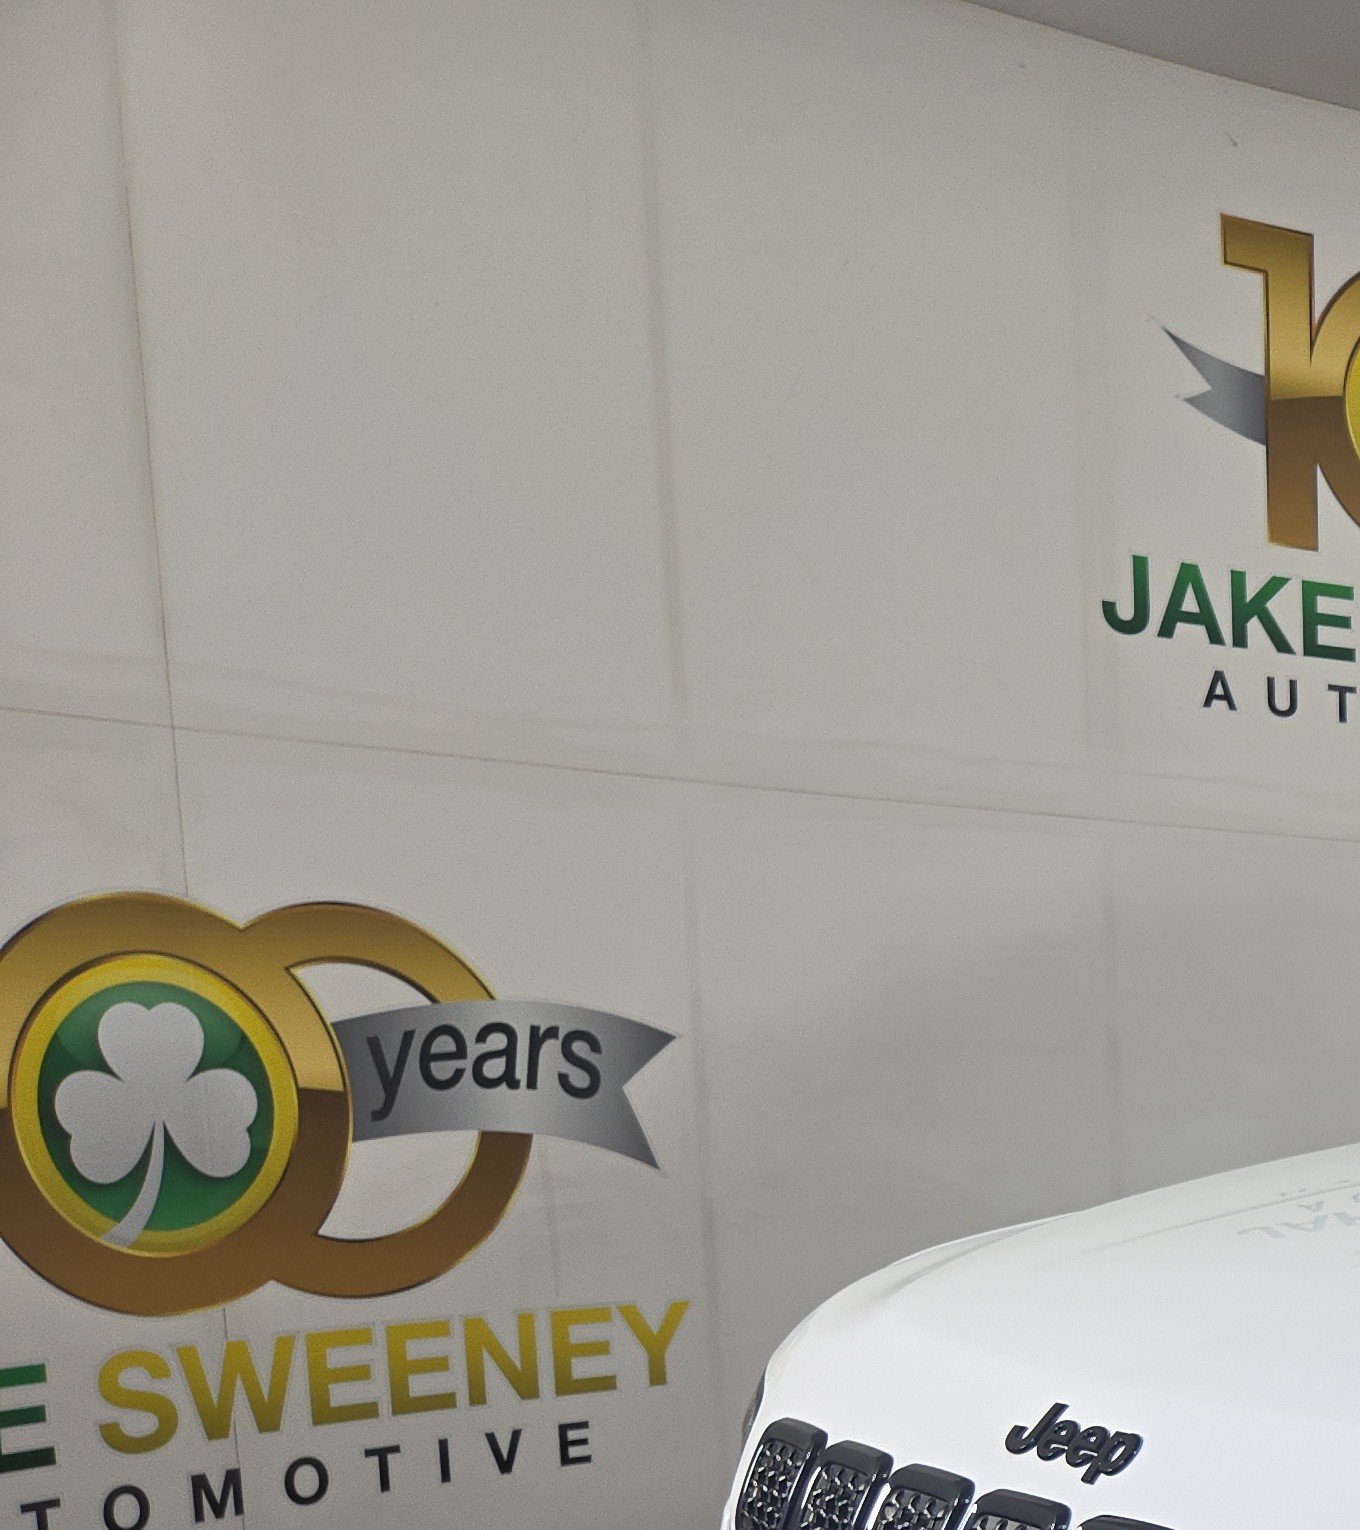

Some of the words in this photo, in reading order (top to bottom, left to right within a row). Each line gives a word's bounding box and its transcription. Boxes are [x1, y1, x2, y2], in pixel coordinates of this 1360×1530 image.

[1101, 554, 1357, 664] JAKE
[366, 1020, 603, 1124] years
[98, 1299, 691, 1456] SWEENEY
[1005, 1402, 1143, 1485] Jeep
